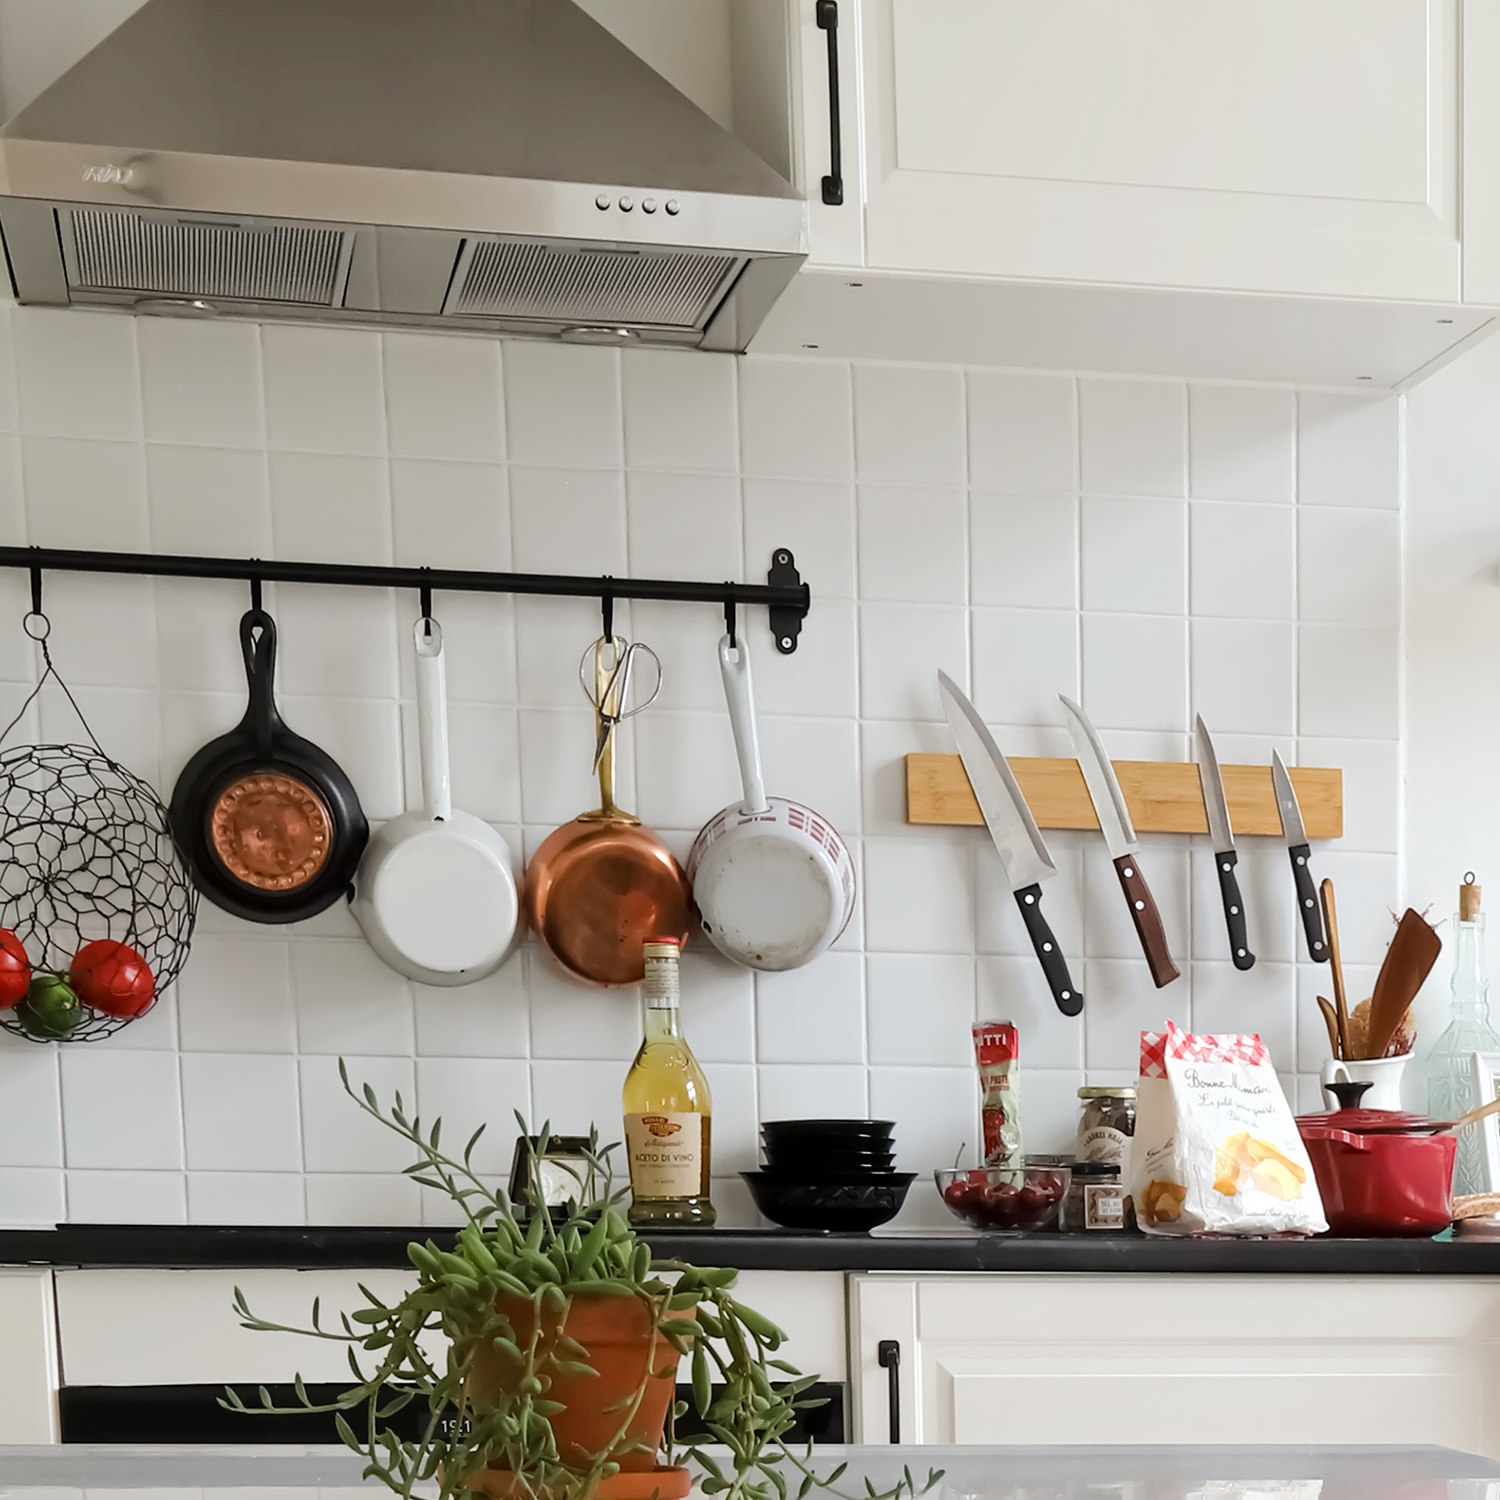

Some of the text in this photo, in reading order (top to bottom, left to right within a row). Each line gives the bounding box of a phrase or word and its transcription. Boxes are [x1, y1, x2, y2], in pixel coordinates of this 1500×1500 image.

[1184, 1068, 1228, 1089] Bonne
[635, 1153, 694, 1163] ACETO DI VINO
